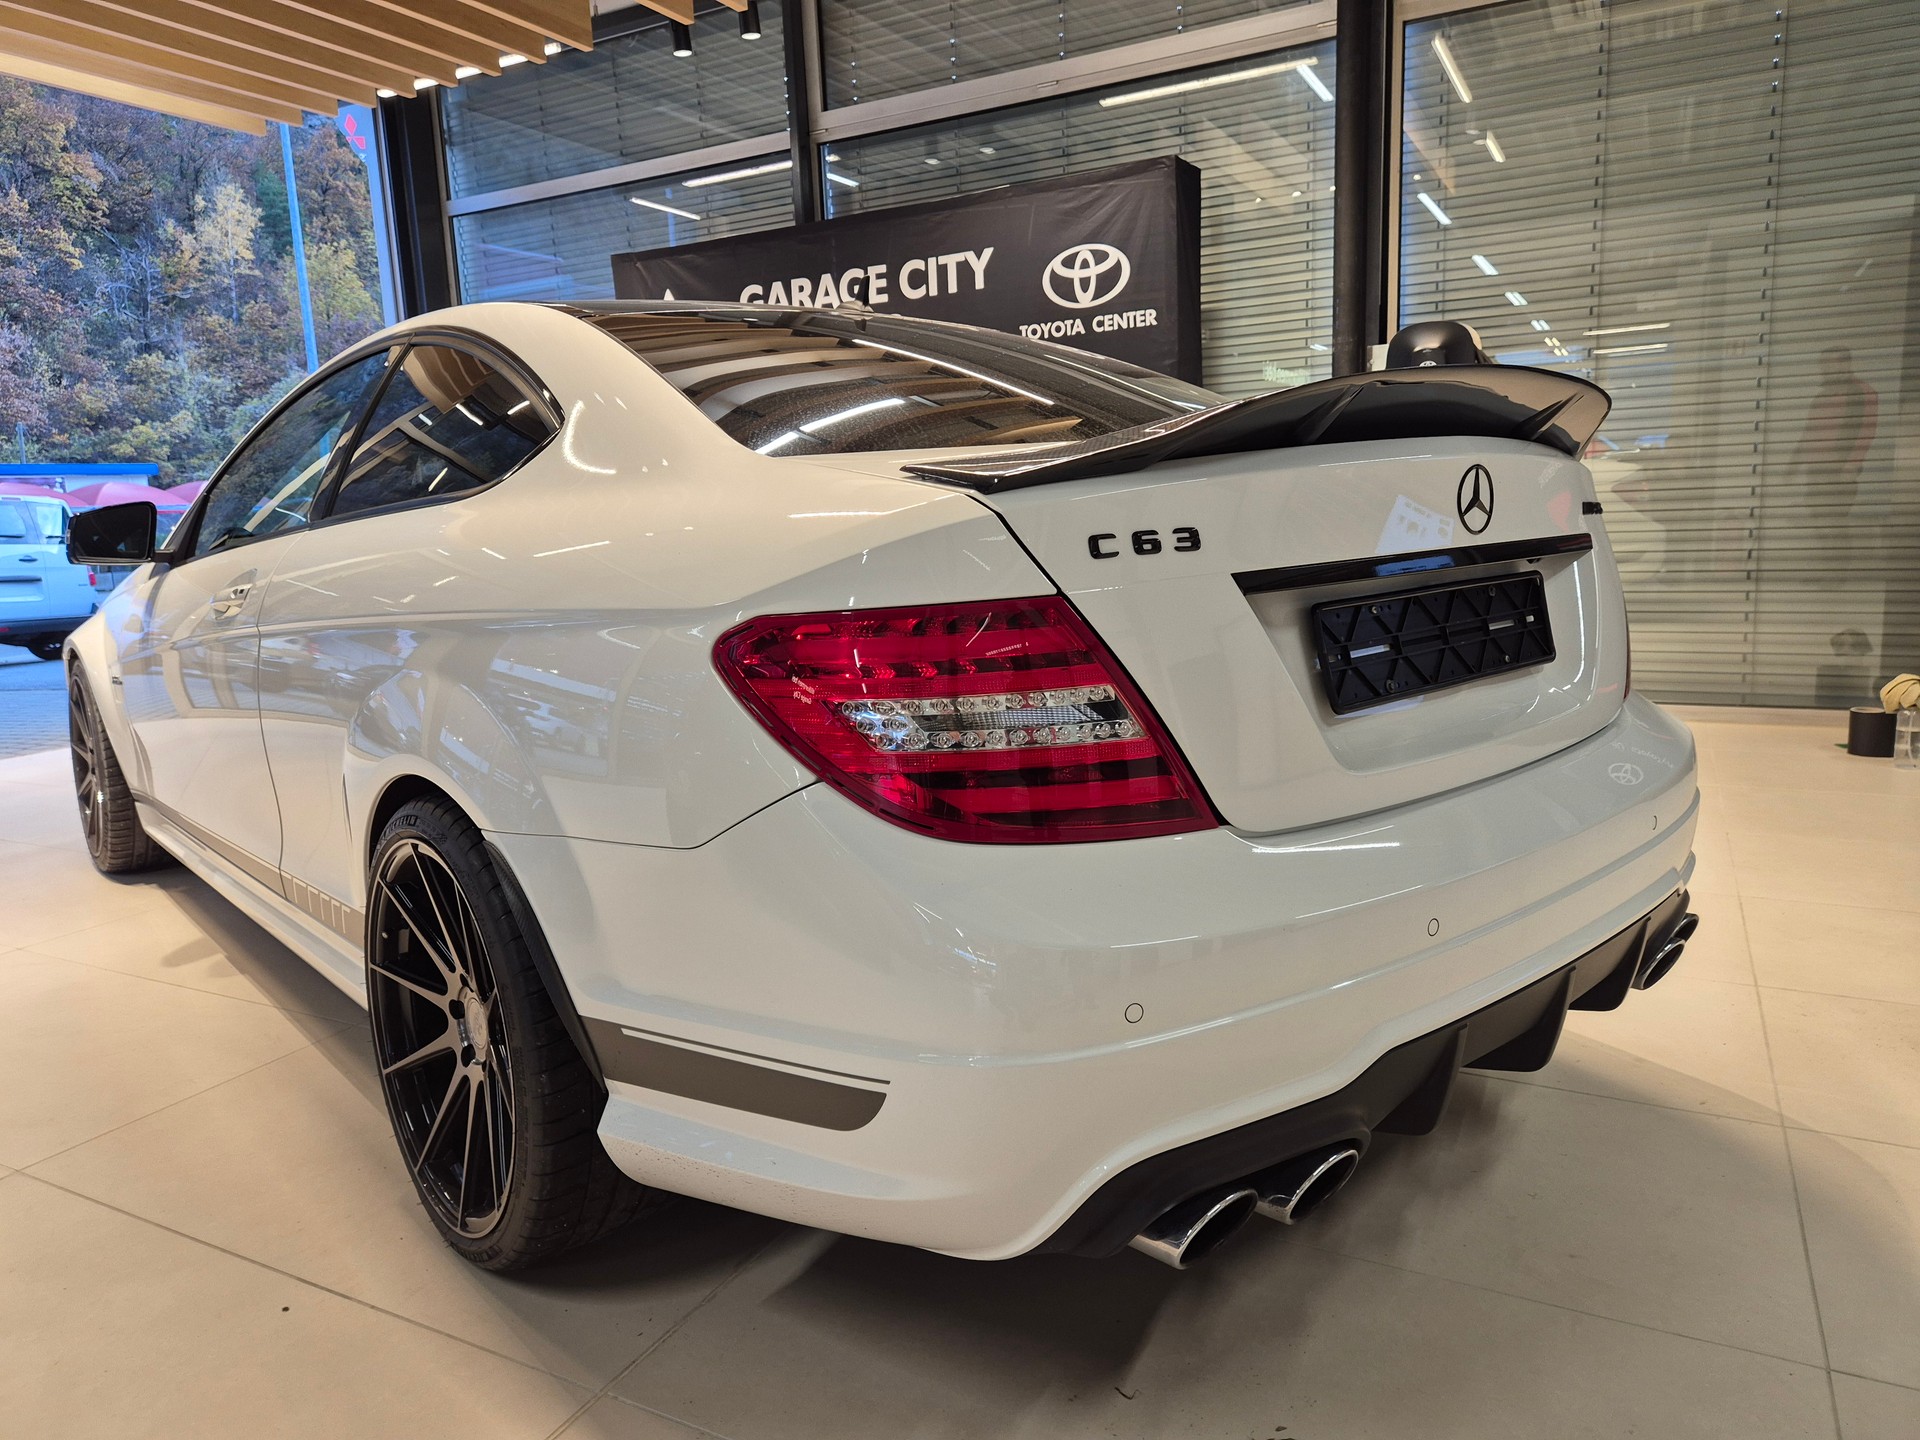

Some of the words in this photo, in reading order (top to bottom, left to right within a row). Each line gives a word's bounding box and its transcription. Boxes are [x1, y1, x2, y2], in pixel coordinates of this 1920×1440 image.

[740, 264, 888, 309] GARAGE
[899, 247, 994, 299] CITY
[1019, 318, 1086, 340] TOYOTA
[1092, 308, 1158, 333] CENTER
